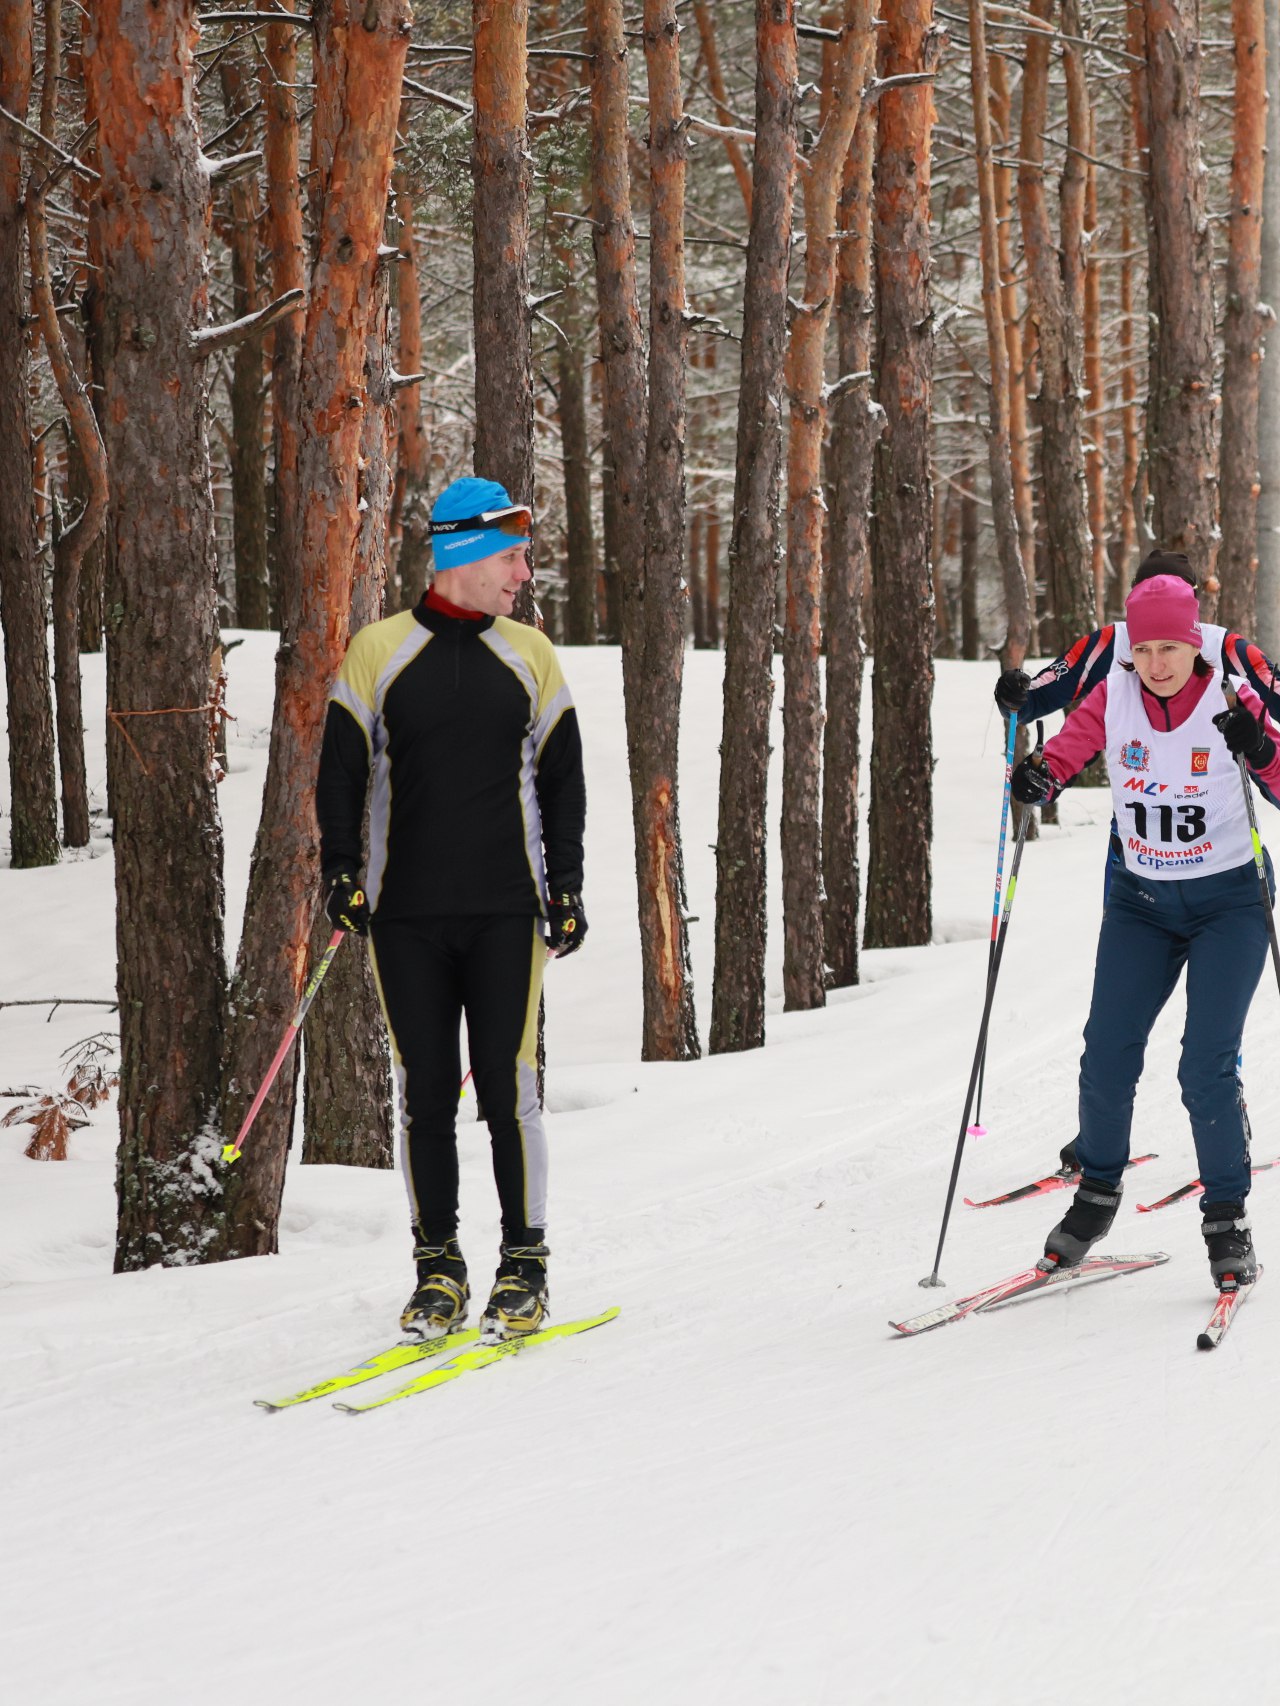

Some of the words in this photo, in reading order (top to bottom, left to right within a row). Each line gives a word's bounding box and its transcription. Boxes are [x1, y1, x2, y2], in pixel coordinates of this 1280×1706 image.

[432, 523, 458, 531] WAY
[1173, 789, 1209, 800] leader
[1124, 801, 1207, 843] 113
[1128, 837, 1213, 859] Магнитная
[1137, 853, 1204, 870] Стрелка
[418, 1337, 448, 1357] FISCHER
[495, 1339, 526, 1357] FISCHER
